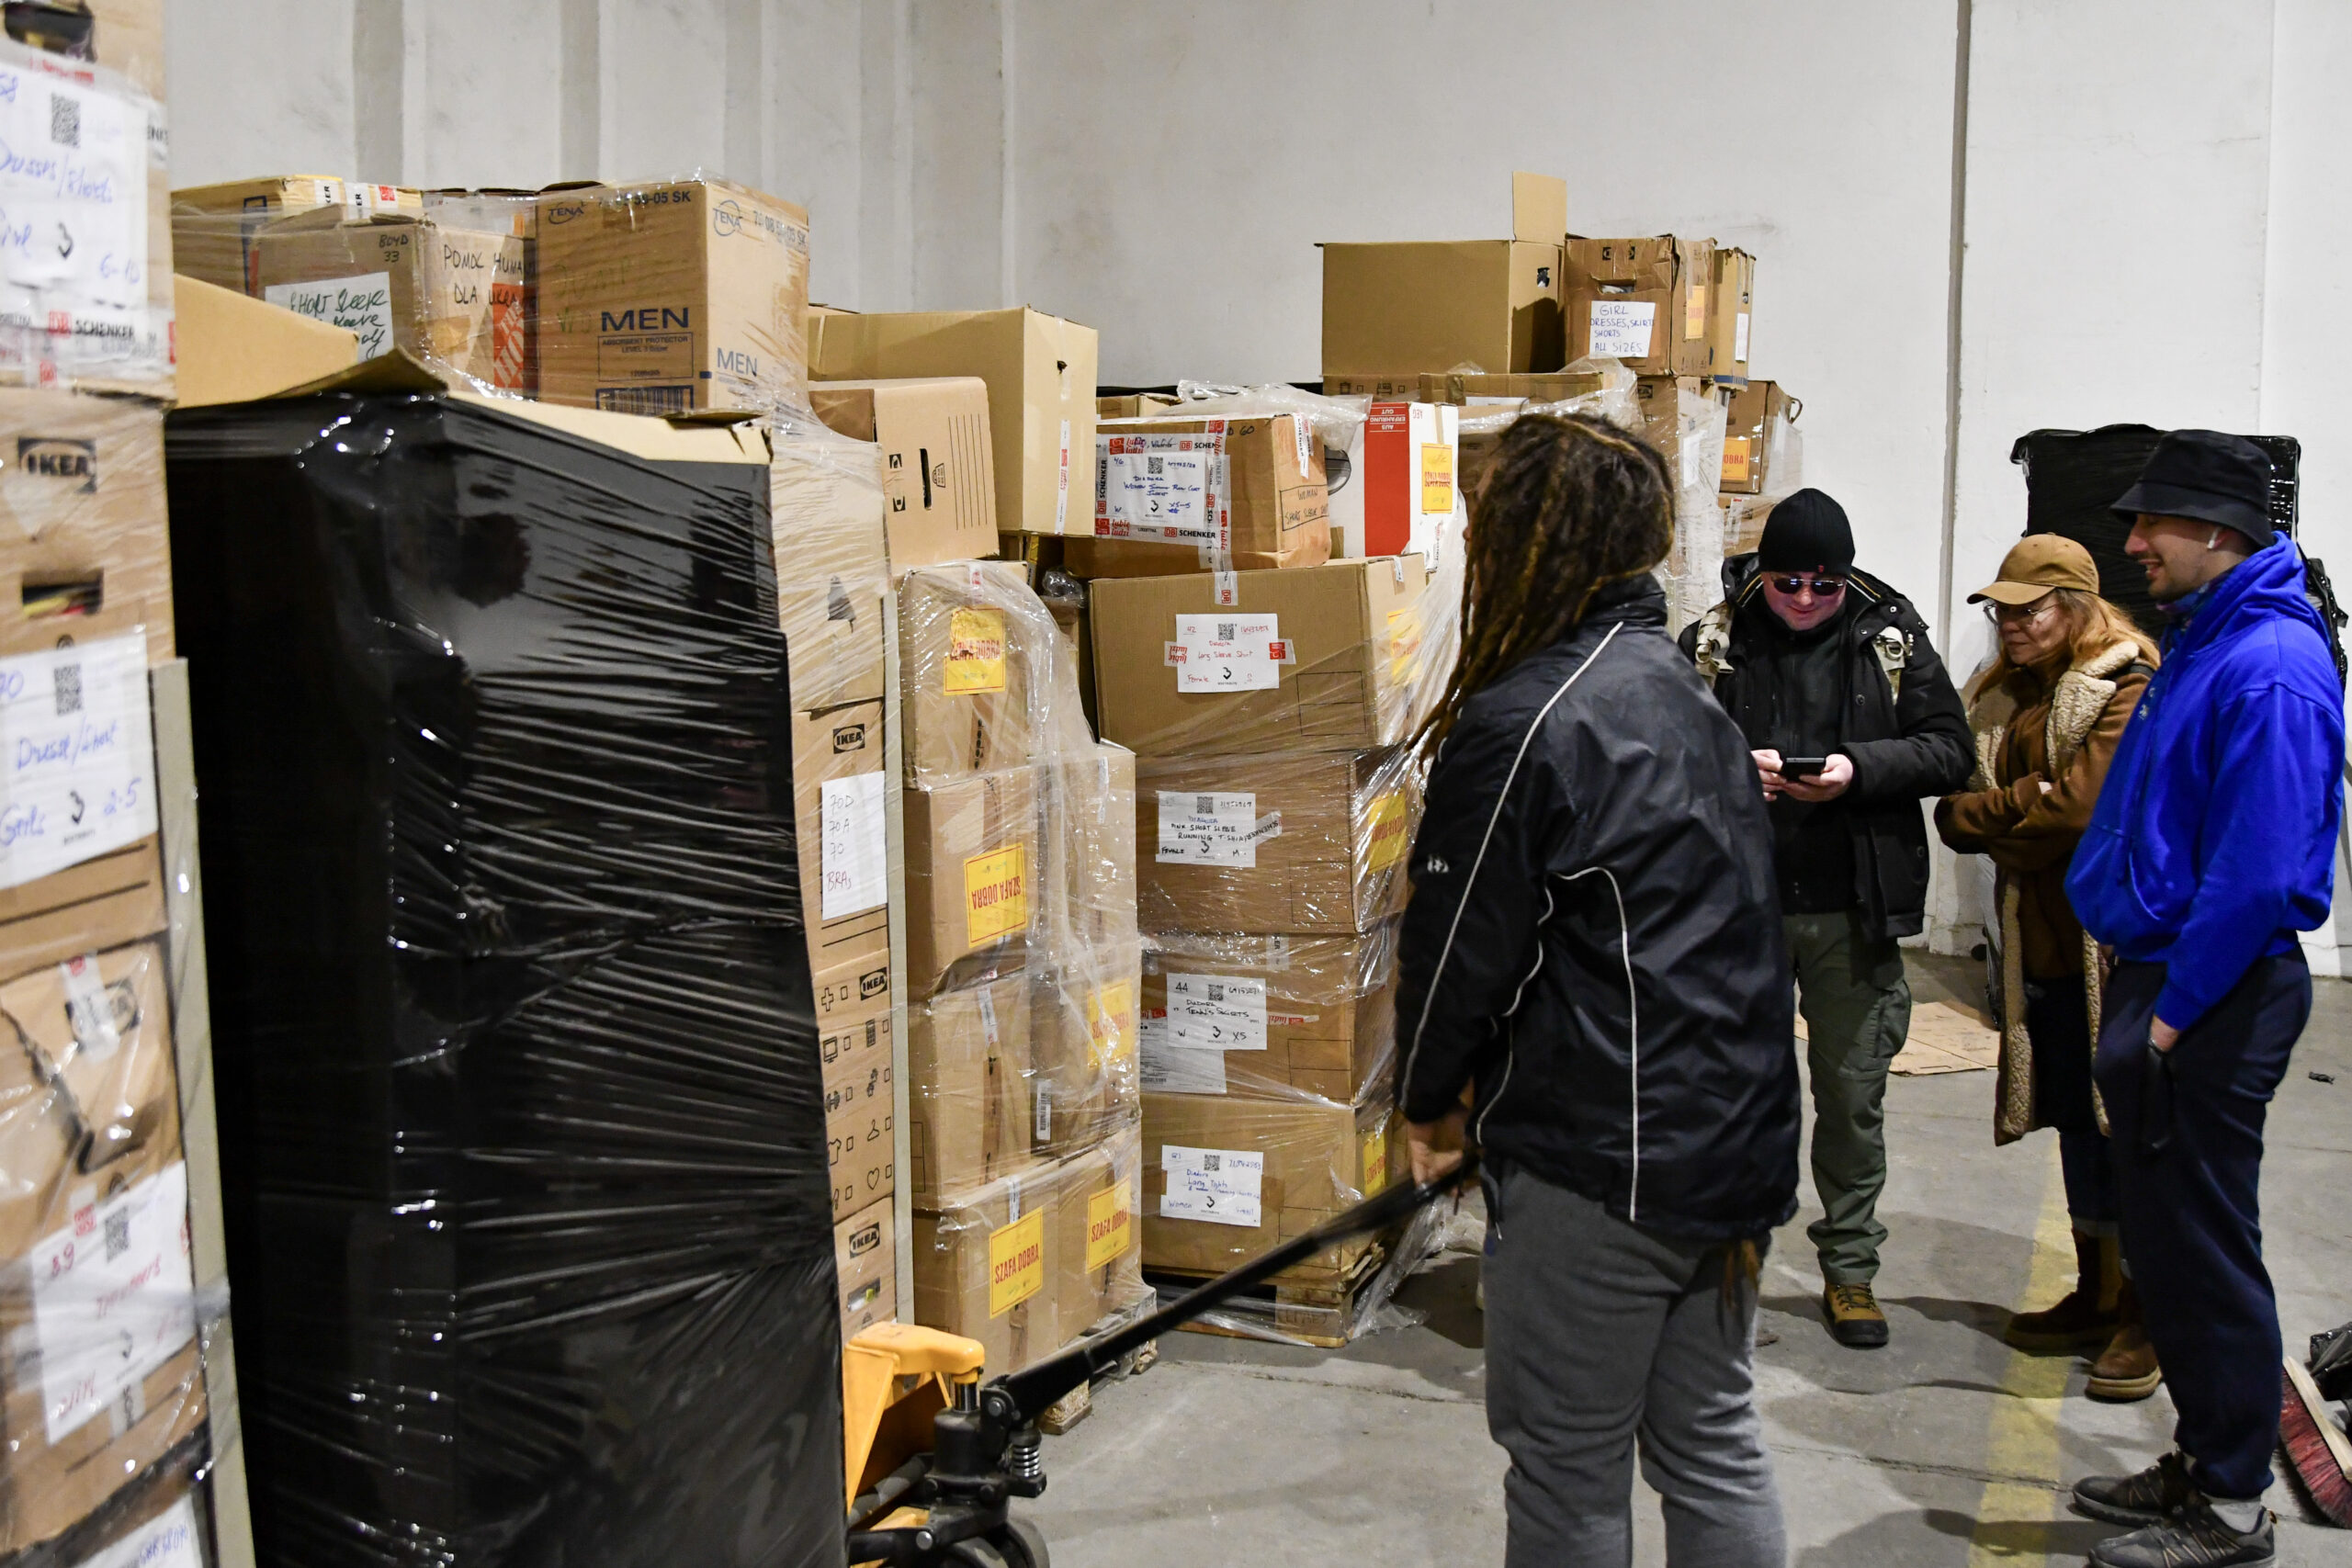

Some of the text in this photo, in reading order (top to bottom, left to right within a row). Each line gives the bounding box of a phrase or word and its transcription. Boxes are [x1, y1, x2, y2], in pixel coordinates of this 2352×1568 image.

[673, 191, 691, 203] SK
[548, 205, 583, 220] TENA
[713, 207, 742, 231] TENA
[384, 251, 400, 263] 33
[444, 243, 484, 270] POMOC
[454, 283, 478, 304] DLA
[601, 308, 689, 333] MEN
[74, 319, 135, 340] SCHENKER
[1595, 330, 1622, 338] SHORTS
[603, 336, 688, 346] ABSORBENT PROTECTOR
[1595, 343, 1607, 352] ALL
[621, 345, 641, 354] LEVEL
[717, 347, 758, 378] MEN
[1180, 441, 1193, 451] DB
[28, 453, 90, 477] IKEA
[1097, 459, 1108, 514] DB SCHENKER
[1165, 527, 1216, 539] DB SCHENKER
[836, 731, 863, 746] IKEA
[1178, 832, 1213, 841] RUNNING
[831, 841, 844, 861] 70
[971, 875, 1022, 910] SZAFA DOBRA
[862, 975, 885, 992] IKEA
[1175, 982, 1189, 993] 44
[1233, 1031, 1247, 1043] XS
[1187, 1179, 1205, 1189] Long
[1169, 1200, 1192, 1210] Women
[1091, 1221, 1112, 1243] SZAFA
[852, 1231, 877, 1250] IKEA
[995, 1243, 1039, 1284] SZAFA DOBRA
